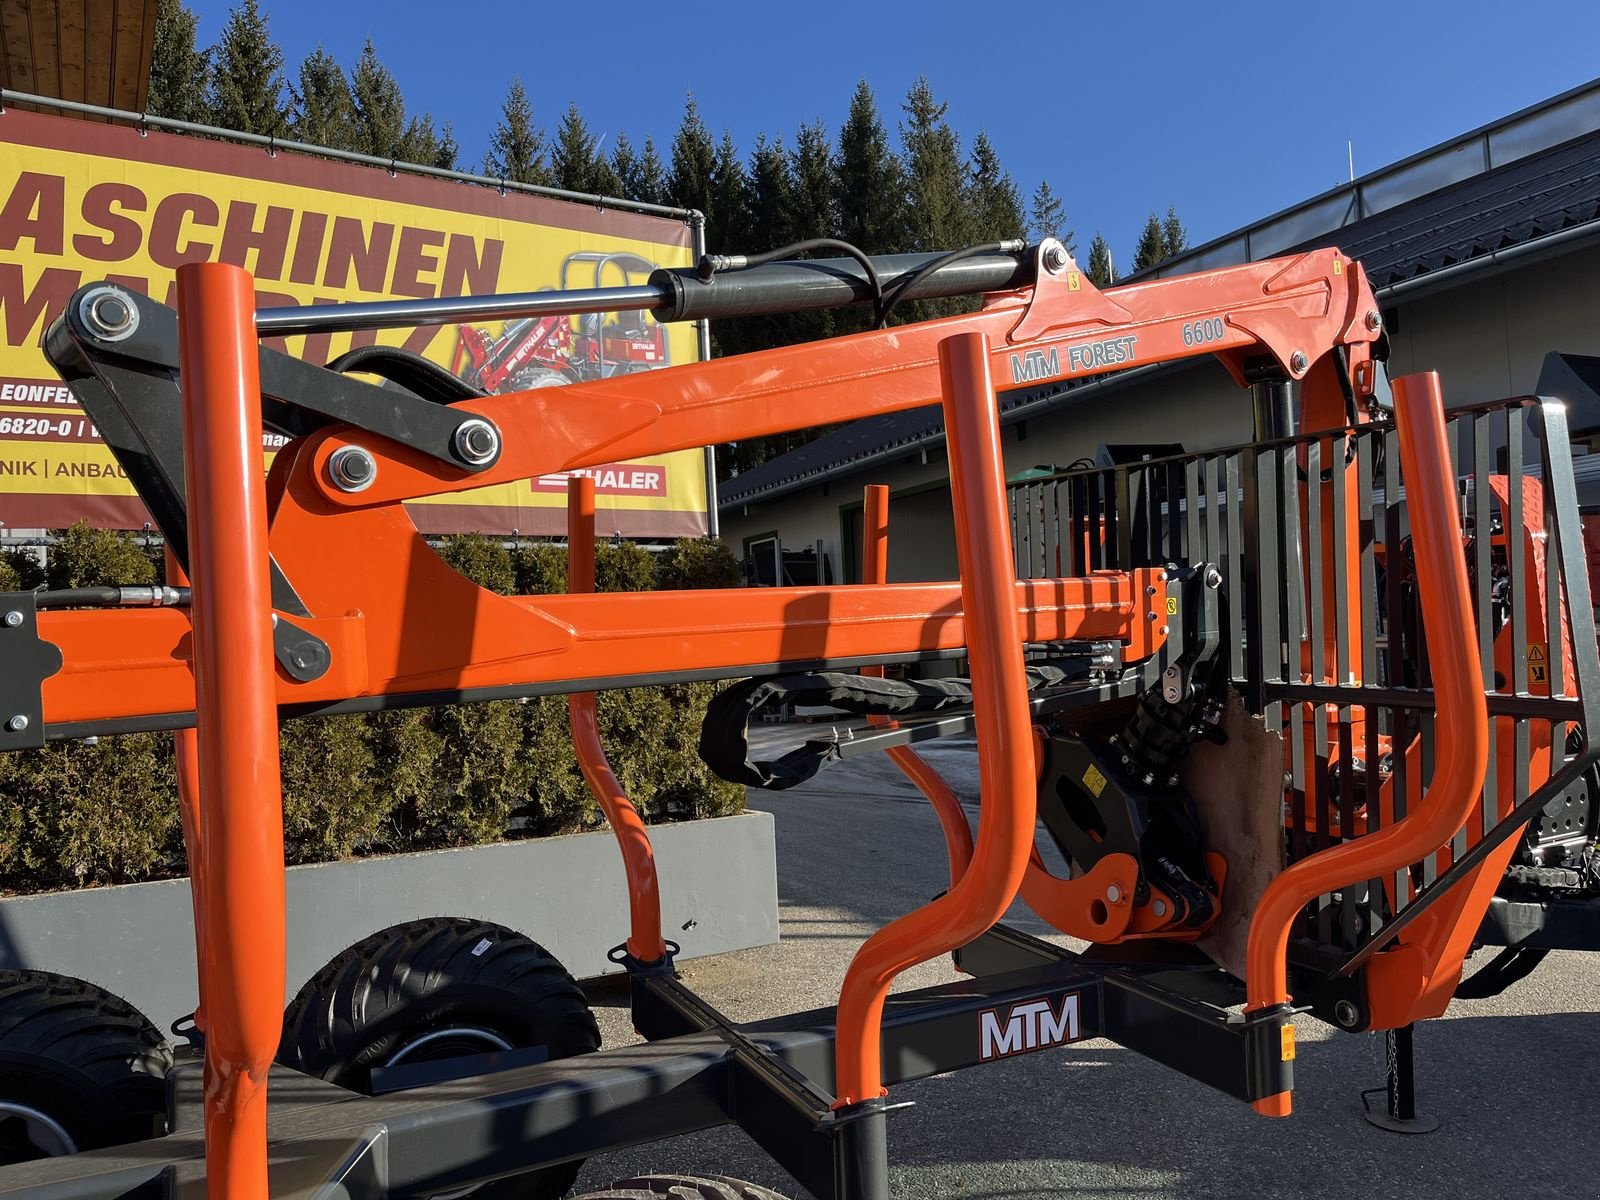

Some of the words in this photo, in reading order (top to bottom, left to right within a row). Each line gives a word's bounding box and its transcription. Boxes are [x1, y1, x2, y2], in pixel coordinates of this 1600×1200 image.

[0, 171, 504, 296] ASCHINEN
[1011, 347, 1060, 384] MTM
[1068, 336, 1137, 373] FOREST
[1183, 317, 1224, 347] 6600
[0, 417, 71, 436] 6820-0
[0, 460, 37, 476] NIK
[981, 995, 1079, 1059] MTM
